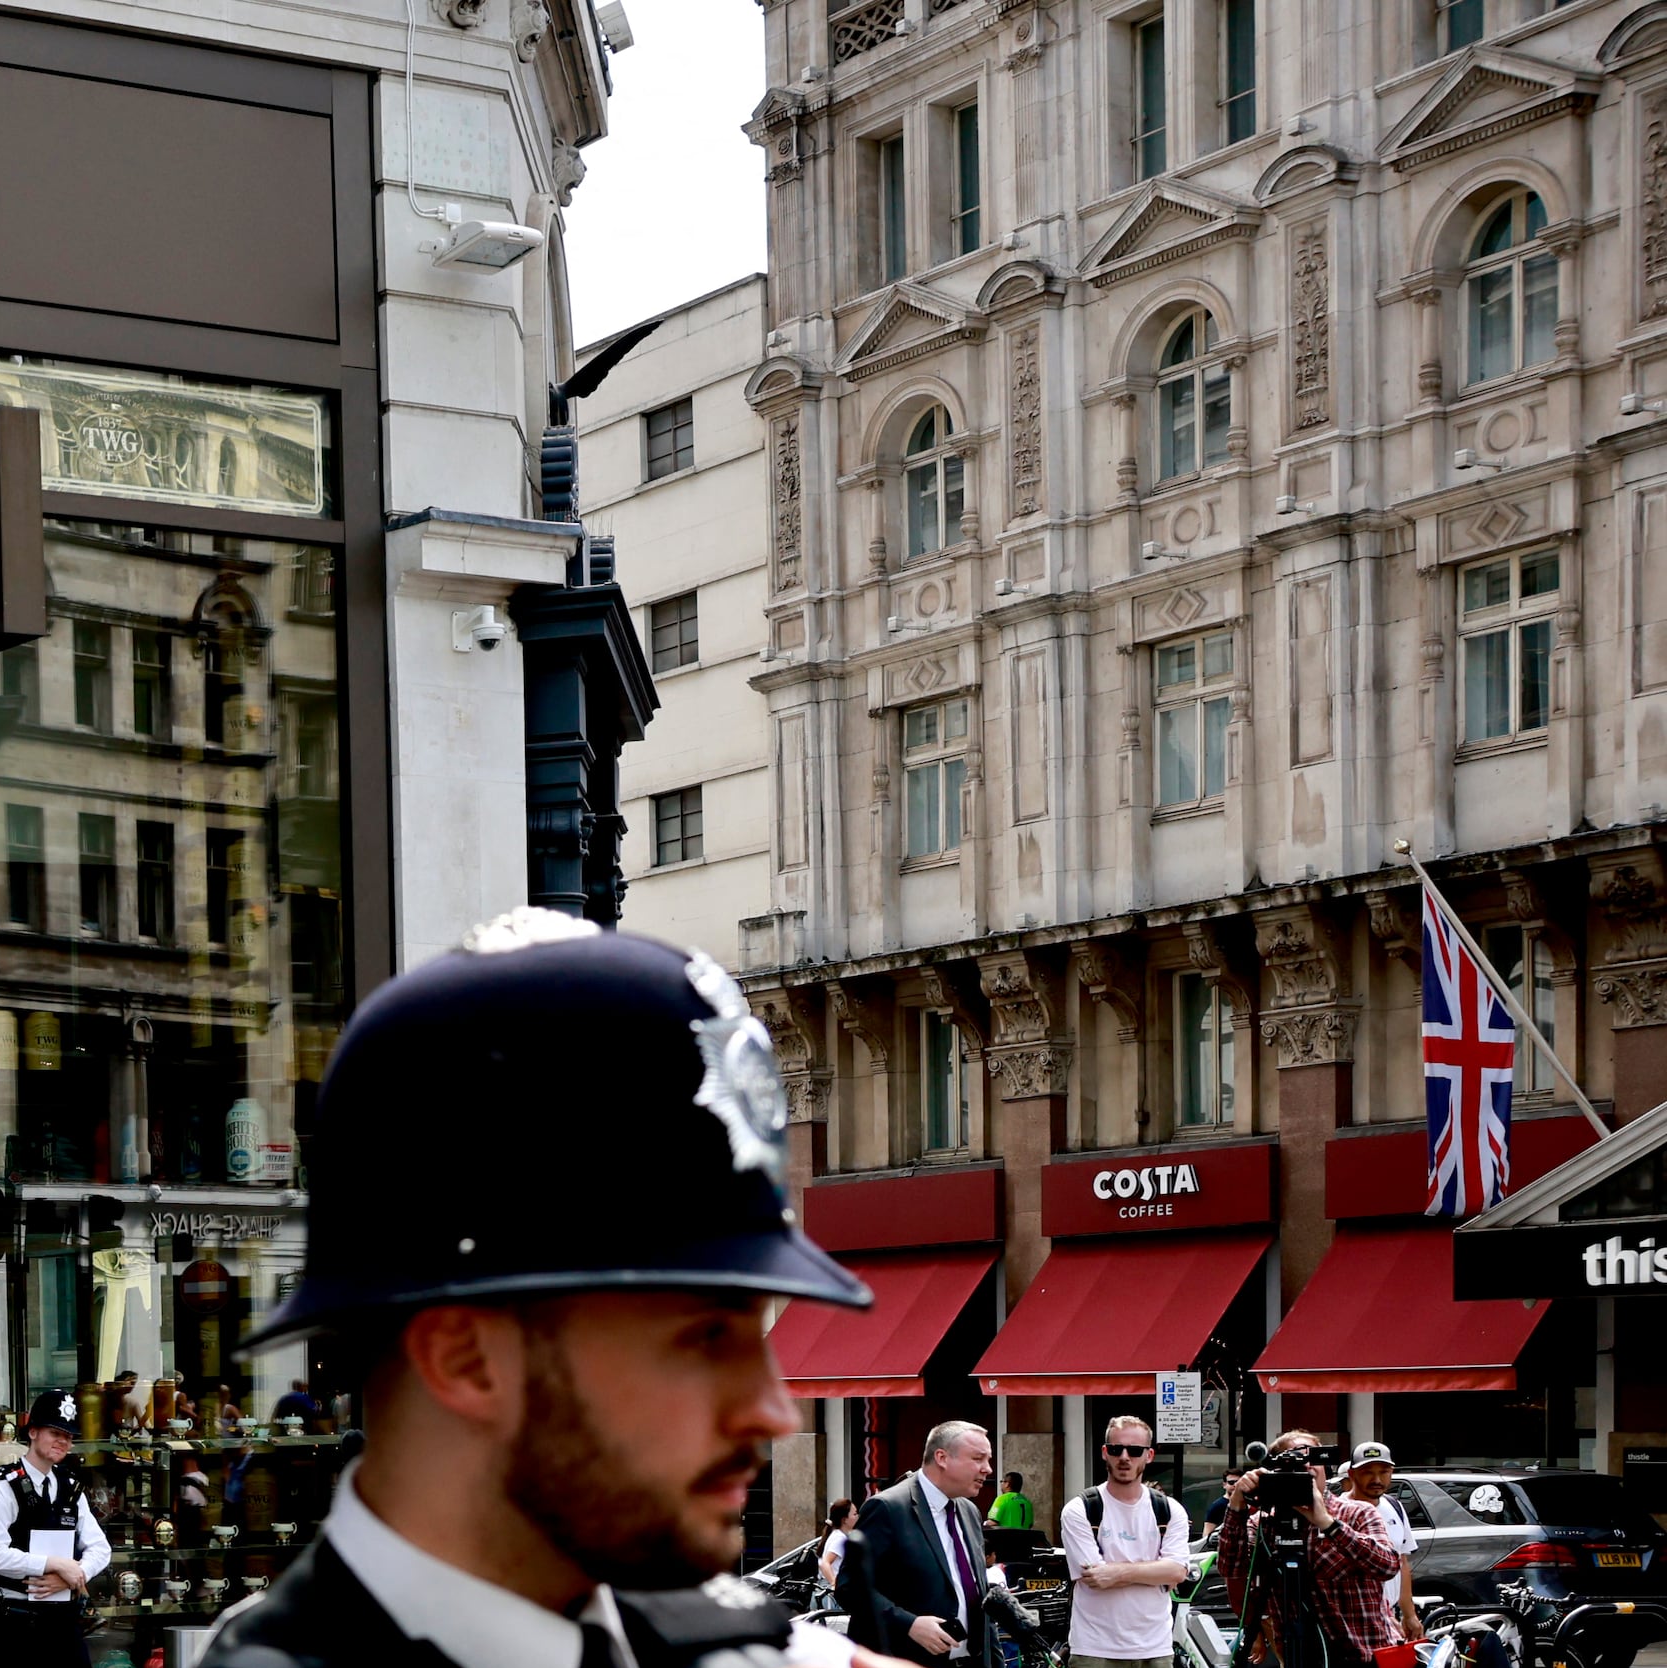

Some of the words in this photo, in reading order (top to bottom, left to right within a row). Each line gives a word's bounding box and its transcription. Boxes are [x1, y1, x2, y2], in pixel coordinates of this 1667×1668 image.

[98, 416, 123, 429] 1837
[83, 427, 139, 453] TWG
[35, 1034, 59, 1045] TWG
[227, 1134, 260, 1152] HOUSE
[1093, 1164, 1199, 1201] COSTA
[1119, 1203, 1174, 1219] COFFEE
[1582, 1236, 1667, 1286] this
[1627, 1452, 1650, 1461] thistle
